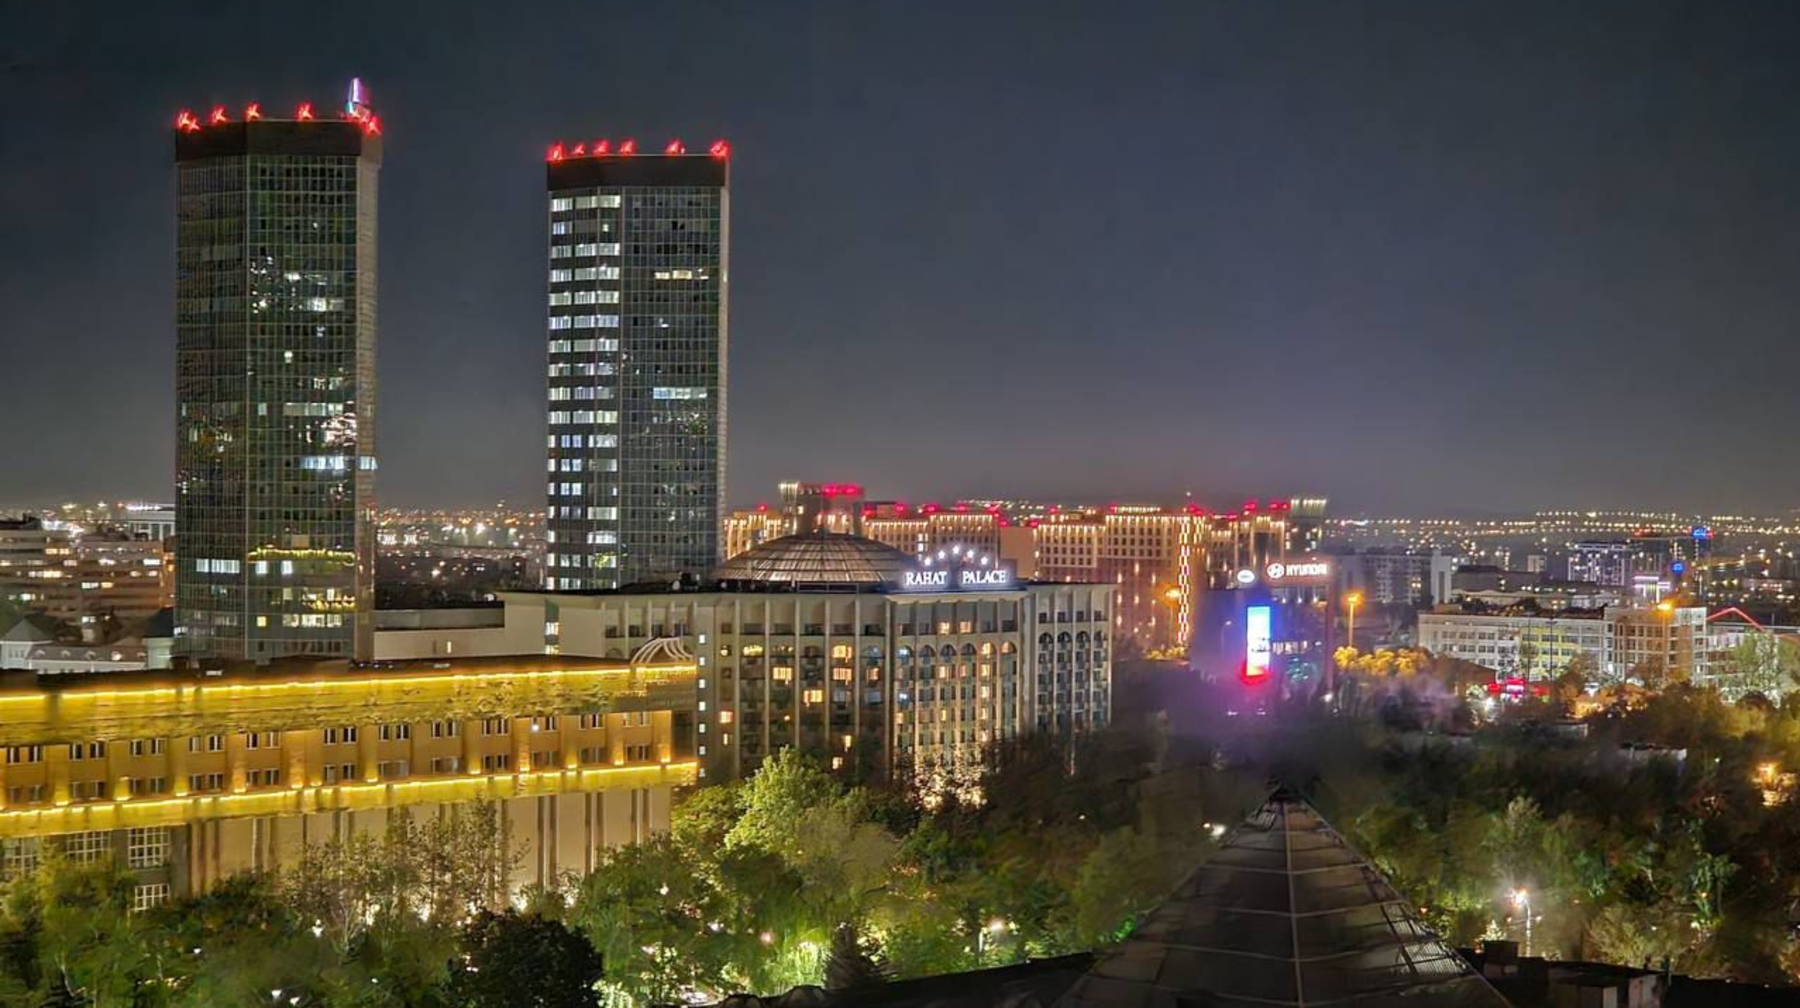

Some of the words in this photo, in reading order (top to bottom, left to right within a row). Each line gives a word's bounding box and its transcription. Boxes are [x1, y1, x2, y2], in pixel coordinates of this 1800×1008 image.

[1286, 563, 1328, 576] HYUNDAI
[905, 571, 947, 585] RAHAT
[962, 570, 1006, 584] PALACE
